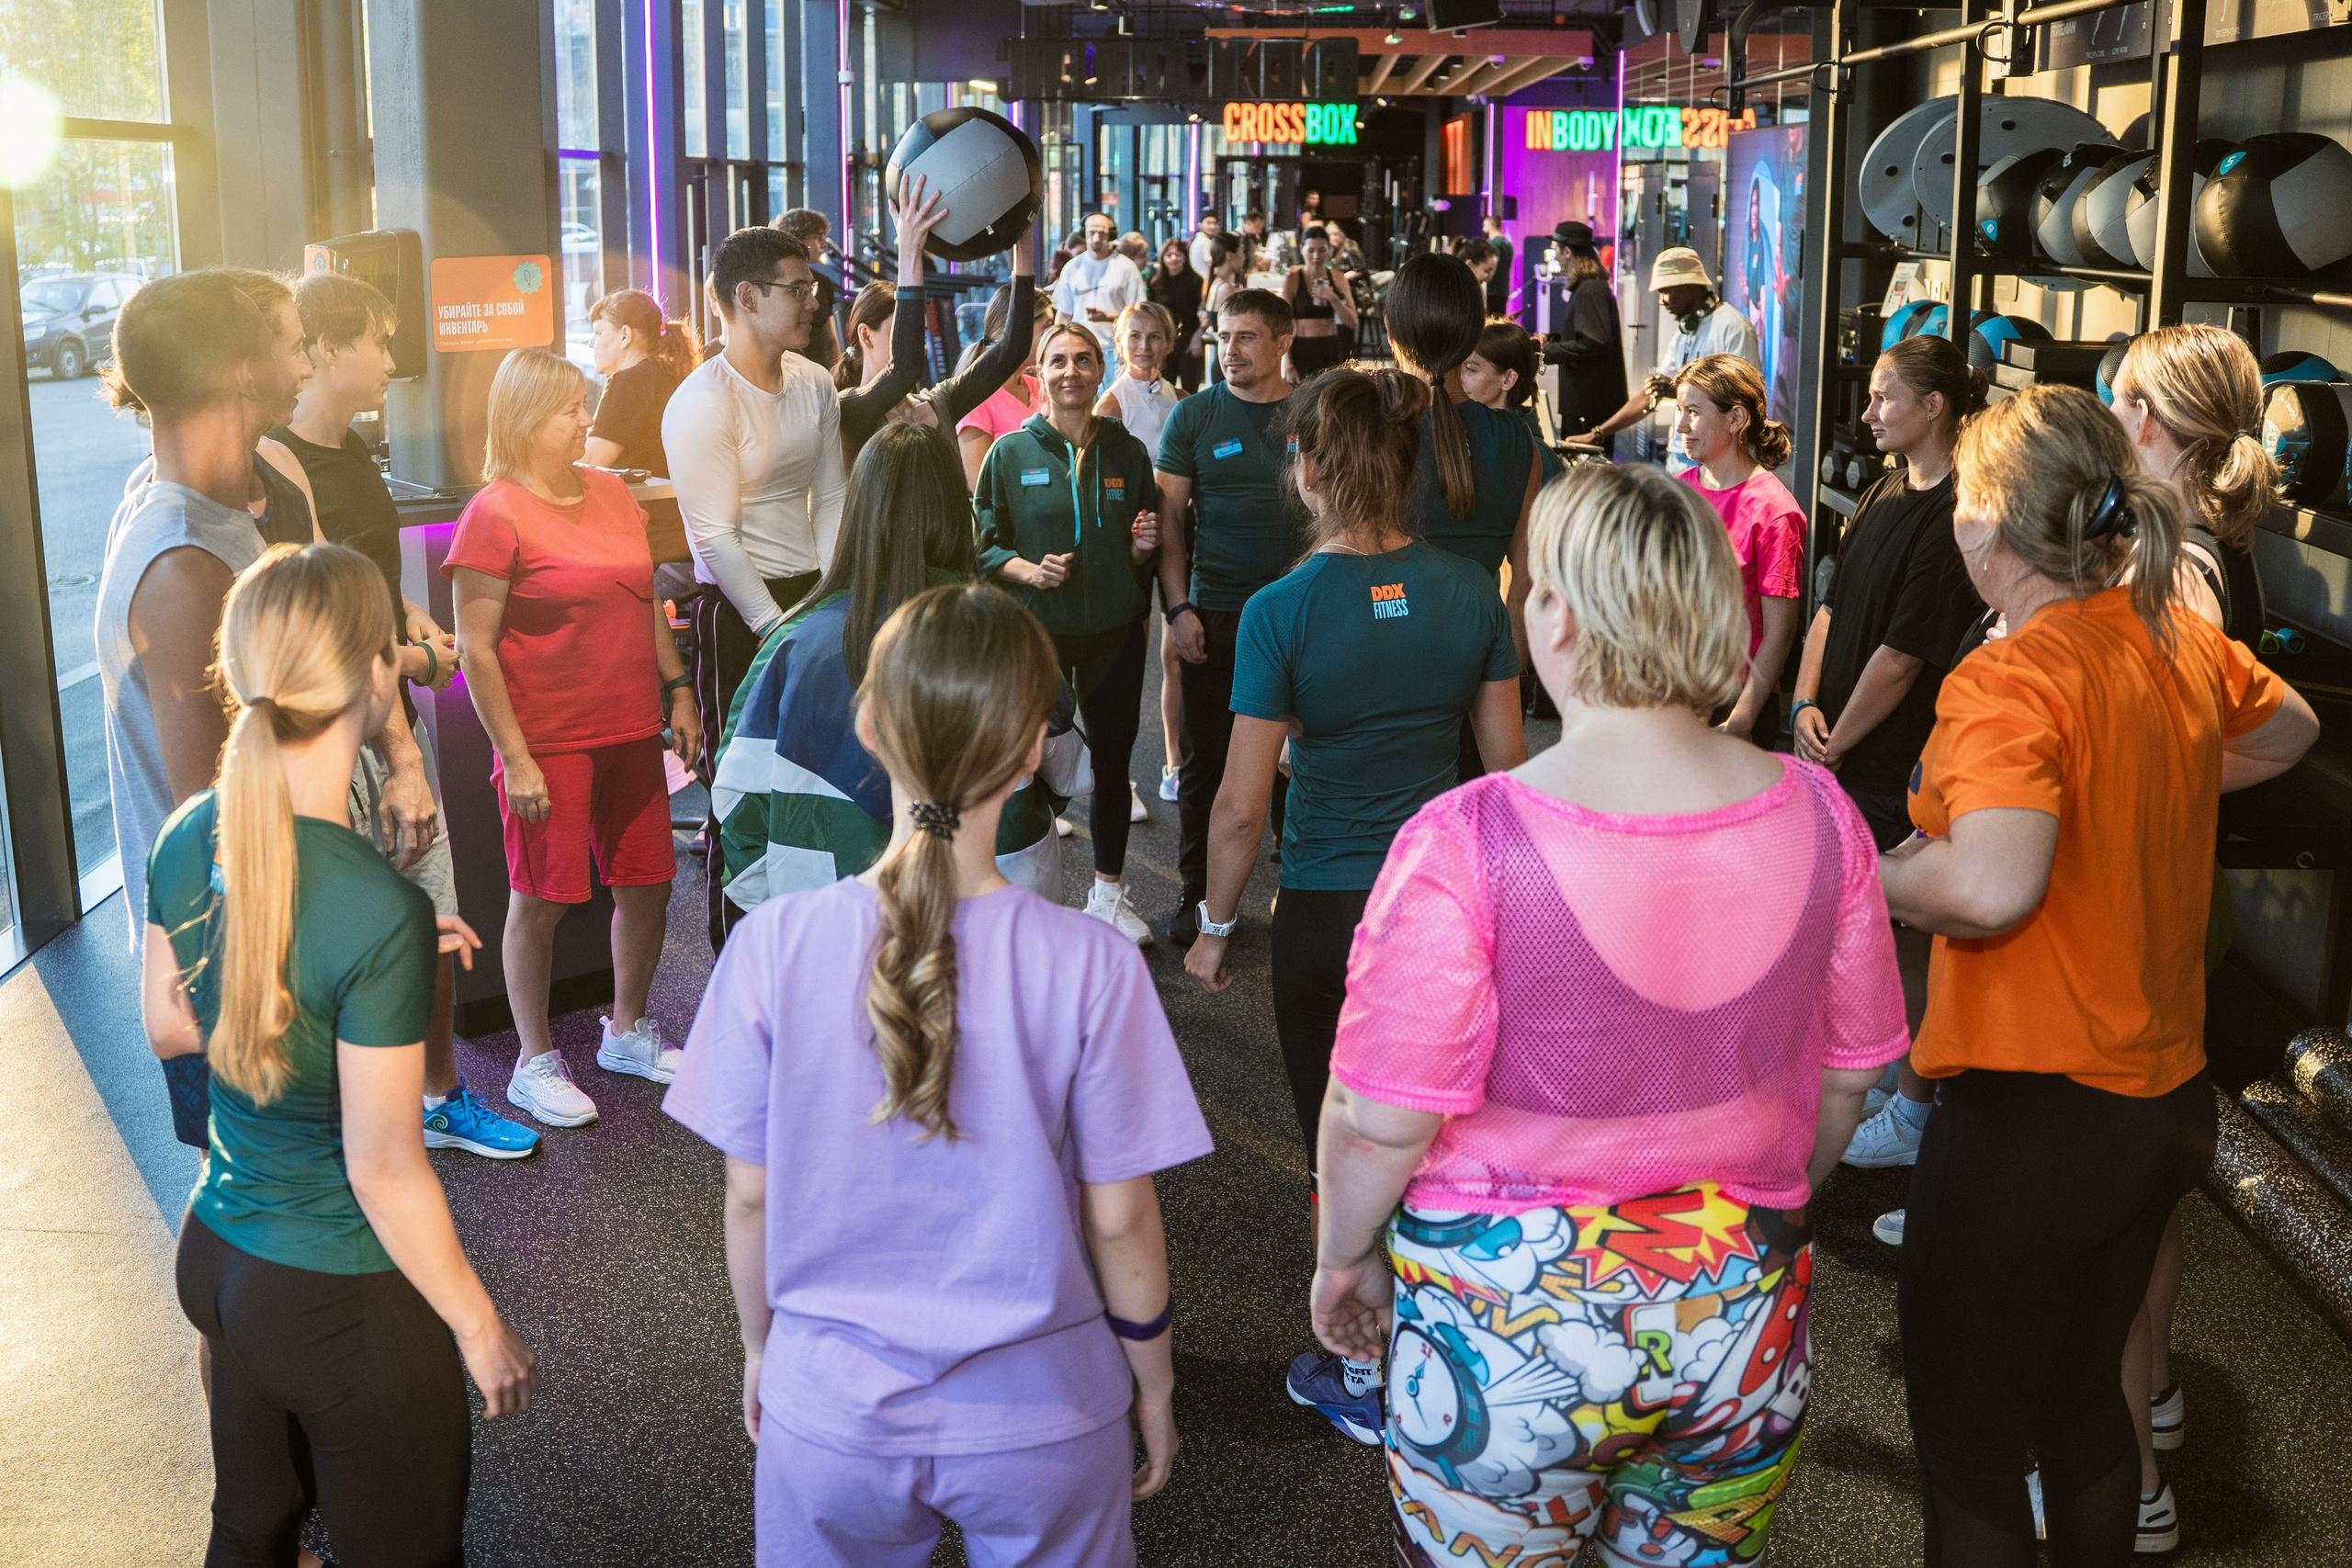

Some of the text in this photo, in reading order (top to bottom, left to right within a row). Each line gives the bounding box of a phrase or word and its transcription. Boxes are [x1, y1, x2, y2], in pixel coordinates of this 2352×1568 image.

[2312, 11, 2331, 22] TRICEP
[1224, 102, 1358, 144] CROSSBOX
[1525, 110, 1618, 151] INBODY
[437, 299, 525, 319] УБИРАЙТЕ ЗА СОБОЙ
[439, 320, 488, 335] ИНВЕНТАРЬ
[1370, 583, 1406, 602] DDX
[1373, 598, 1408, 619] FITNESS
